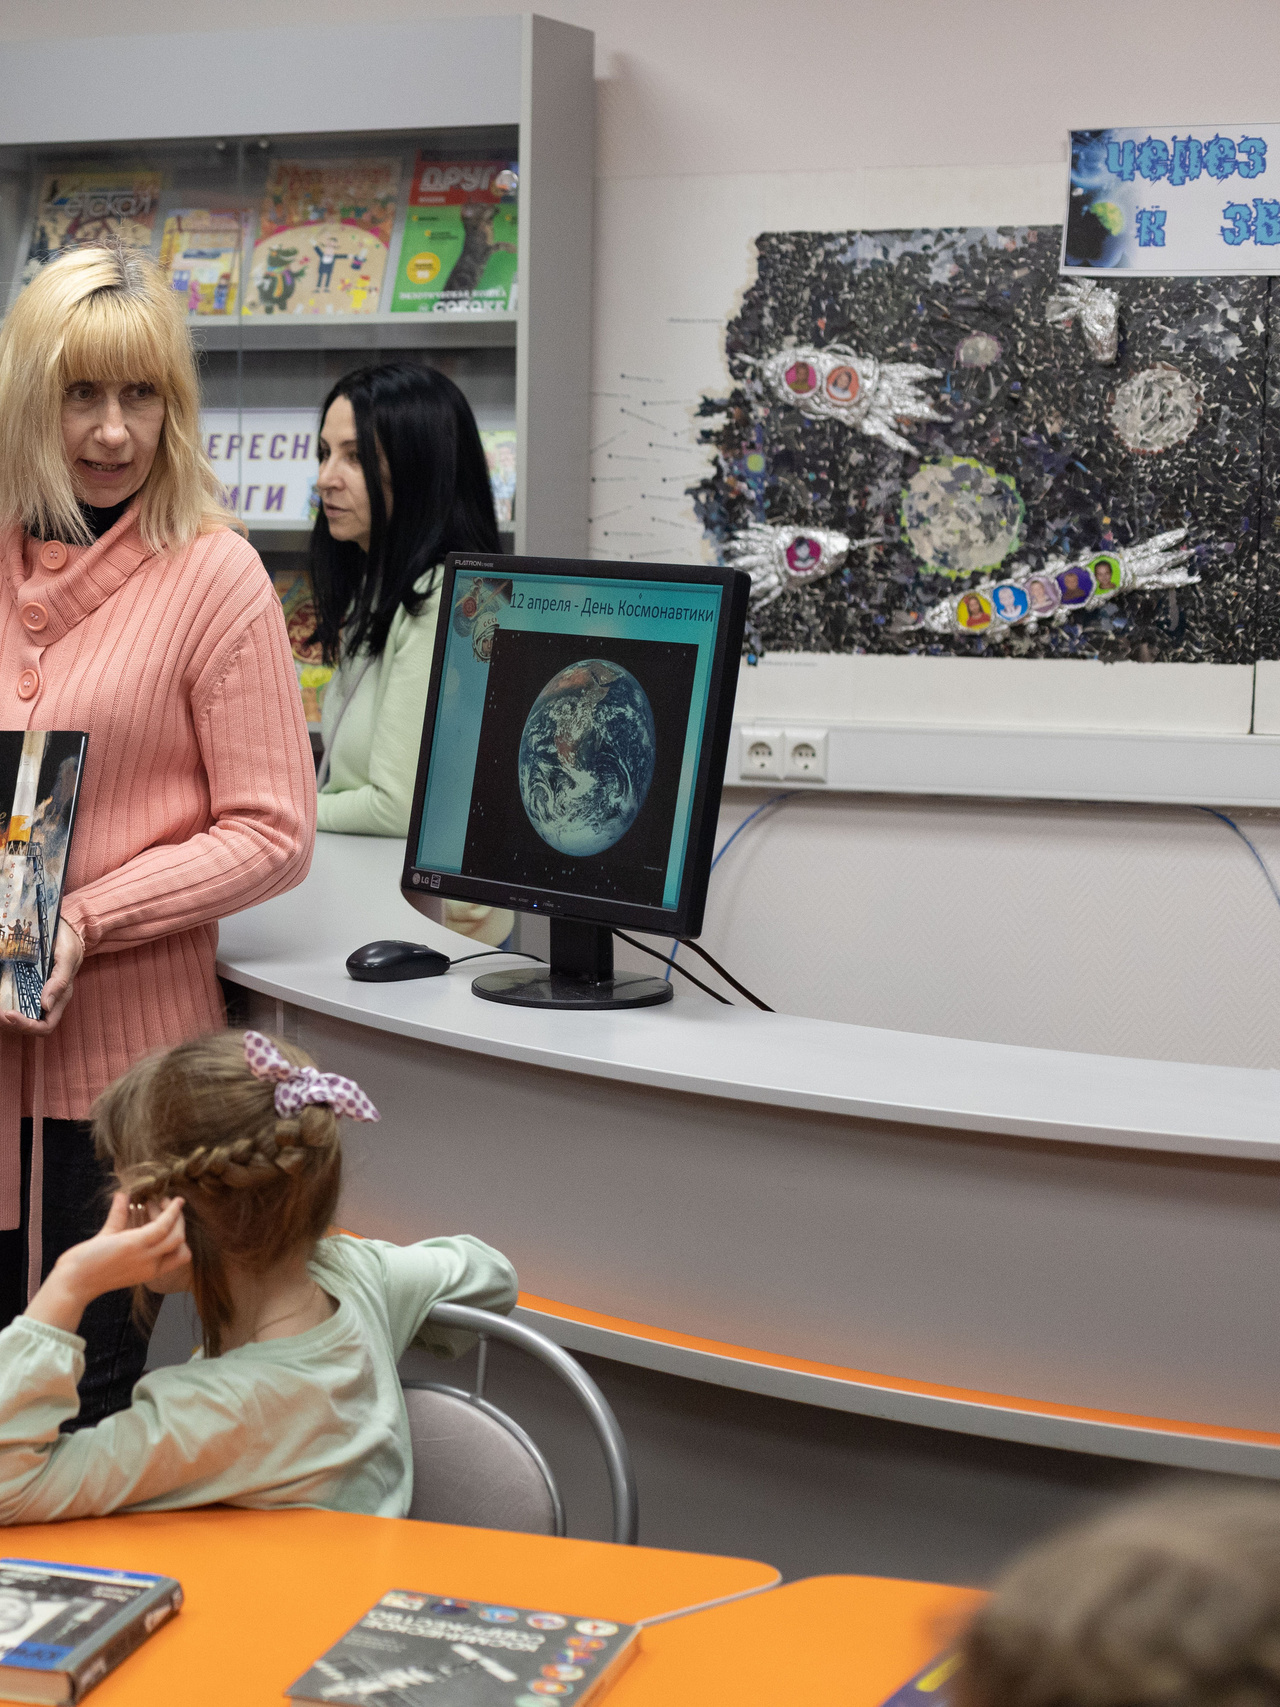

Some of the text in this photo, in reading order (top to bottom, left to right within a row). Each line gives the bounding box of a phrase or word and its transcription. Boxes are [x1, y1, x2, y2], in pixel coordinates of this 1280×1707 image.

[208, 433, 312, 460] ЕРЕСН
[509, 592, 525, 609] 12
[527, 597, 571, 614] апреля
[580, 597, 615, 617] День
[617, 599, 714, 623] Космонавтики
[420, 876, 430, 885] LG
